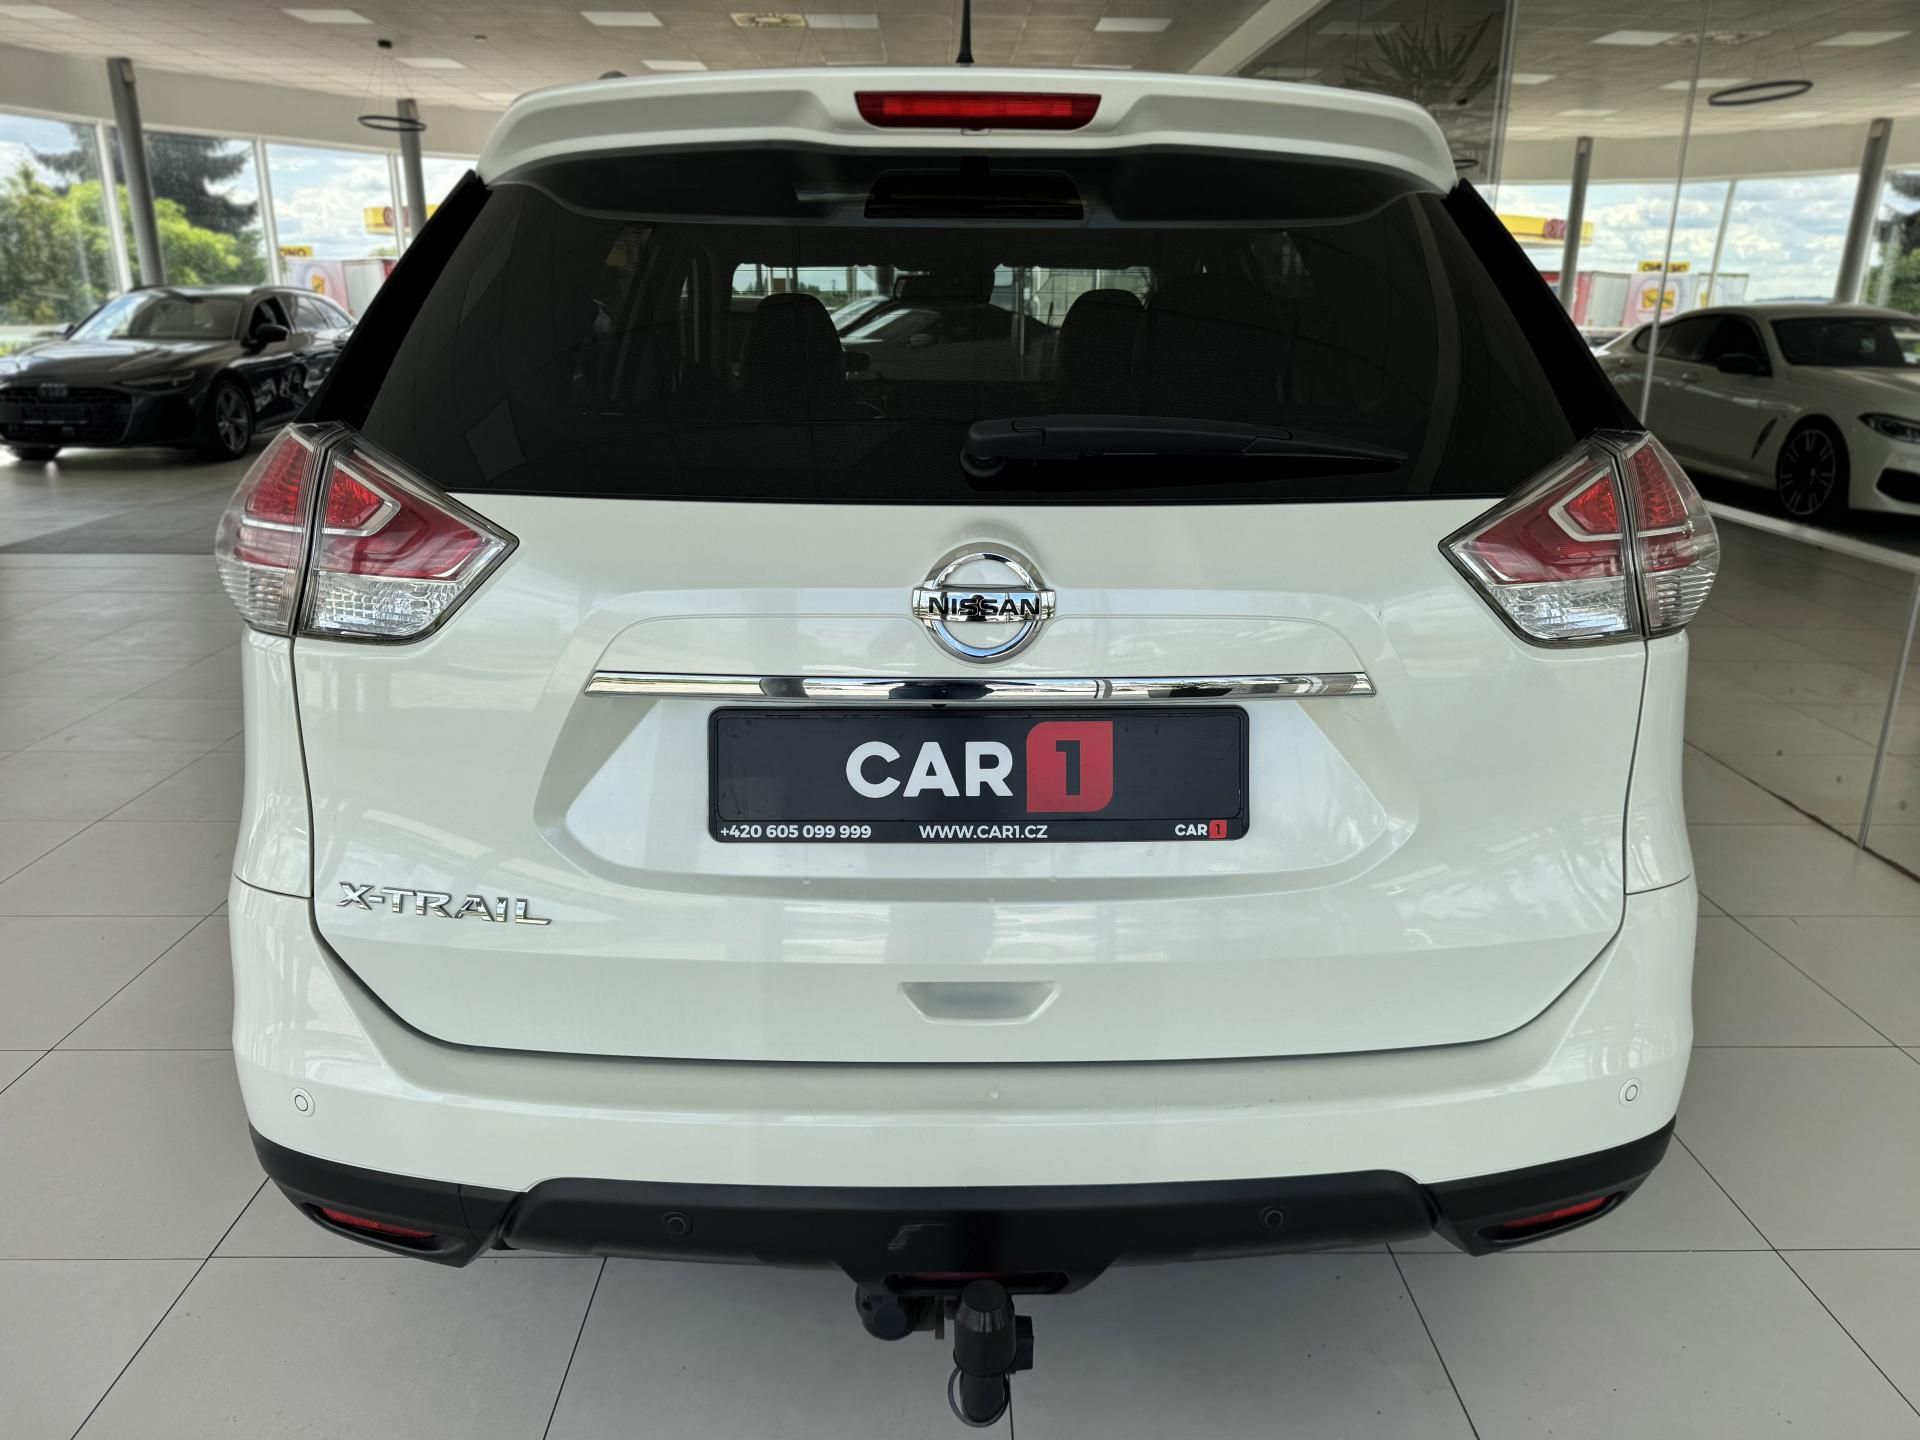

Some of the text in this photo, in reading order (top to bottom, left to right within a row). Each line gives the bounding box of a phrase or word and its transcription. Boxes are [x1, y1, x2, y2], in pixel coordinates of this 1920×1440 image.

[928, 597, 1041, 616] NISSAN
[720, 824, 872, 839] +420 605 099 999
[918, 824, 1048, 839] WWW.CAR1.CZ
[336, 881, 553, 926] X-TRAIL
